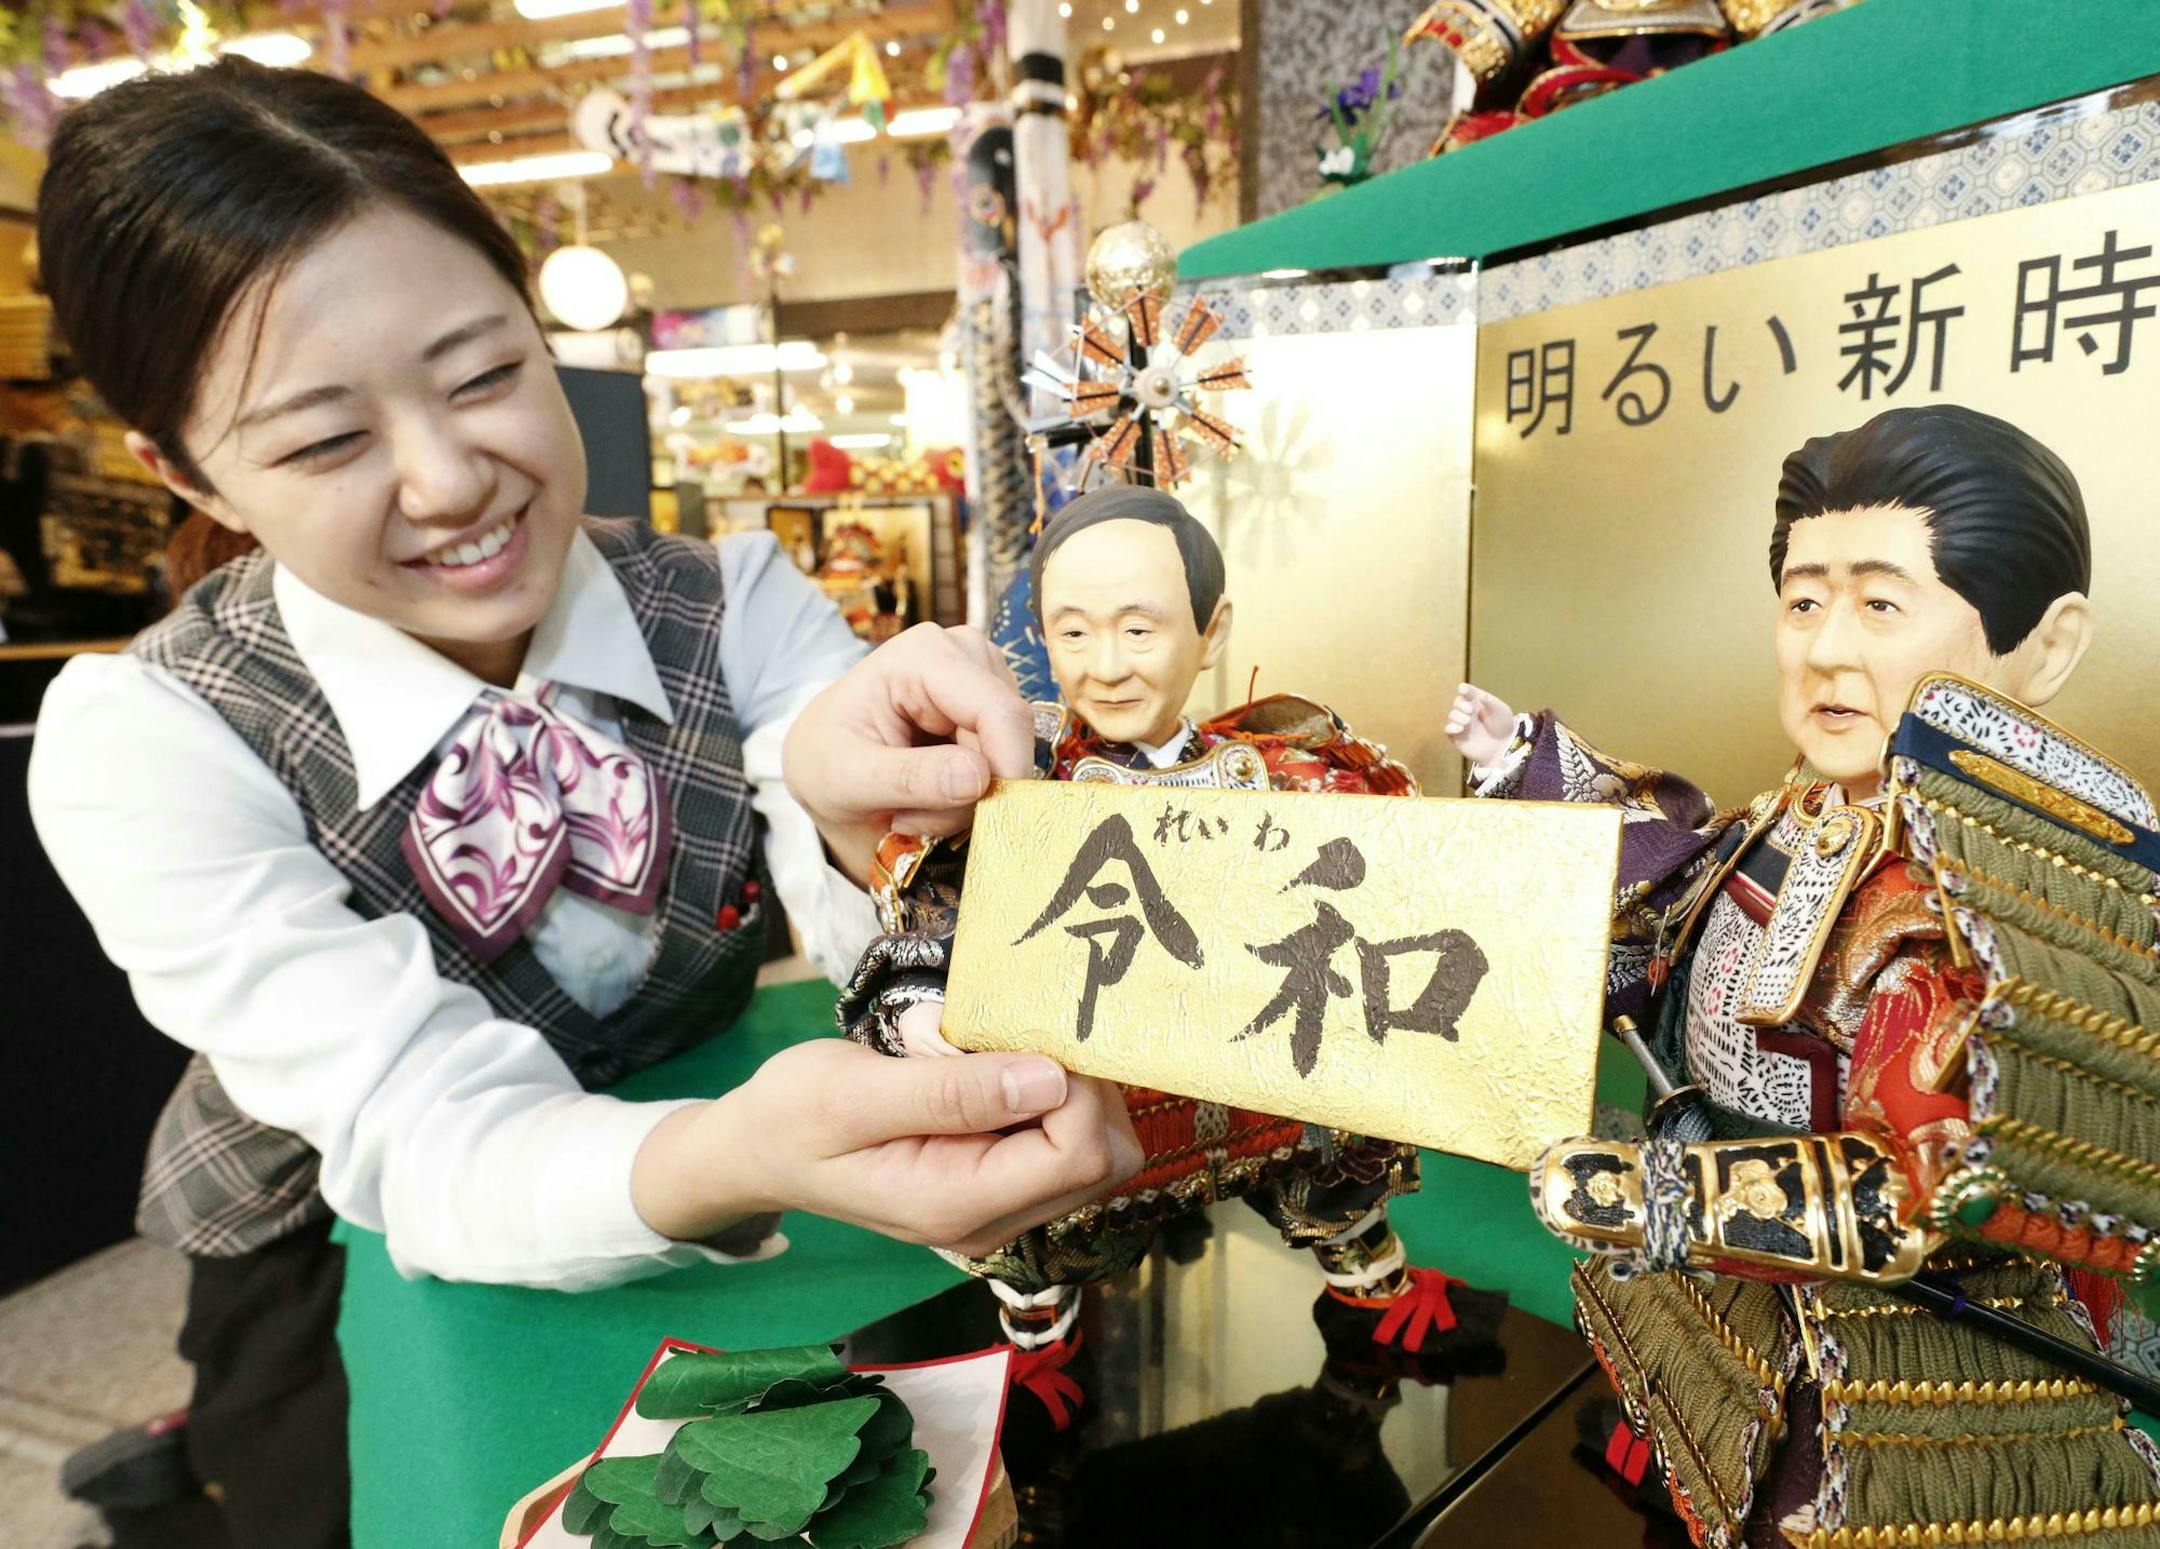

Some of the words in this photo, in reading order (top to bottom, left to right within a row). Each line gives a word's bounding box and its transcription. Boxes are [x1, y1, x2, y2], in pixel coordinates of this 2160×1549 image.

[1505, 230, 2160, 440] 明るい新時
[1011, 813, 1490, 1079] 令和
